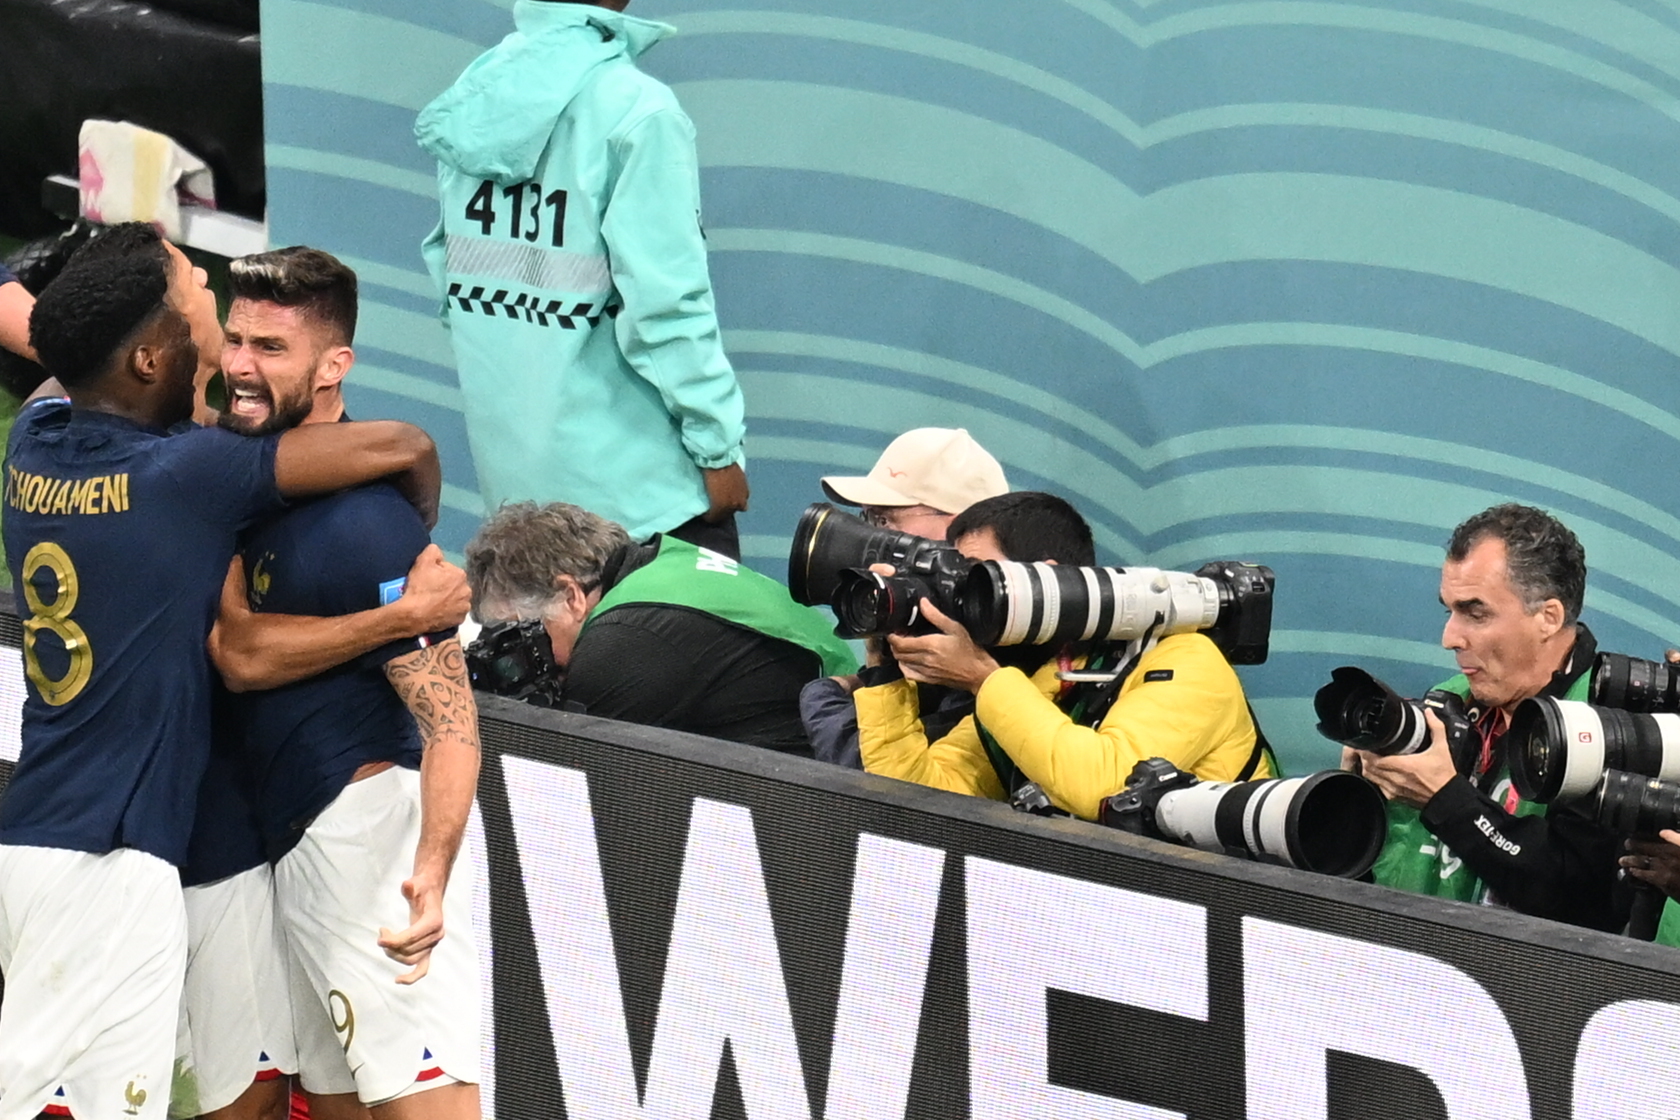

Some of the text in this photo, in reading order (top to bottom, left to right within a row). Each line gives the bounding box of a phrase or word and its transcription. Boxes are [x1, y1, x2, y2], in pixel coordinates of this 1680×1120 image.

[465, 180, 568, 248] 4131
[22, 541, 93, 706] 8
[328, 989, 355, 1056] 9
